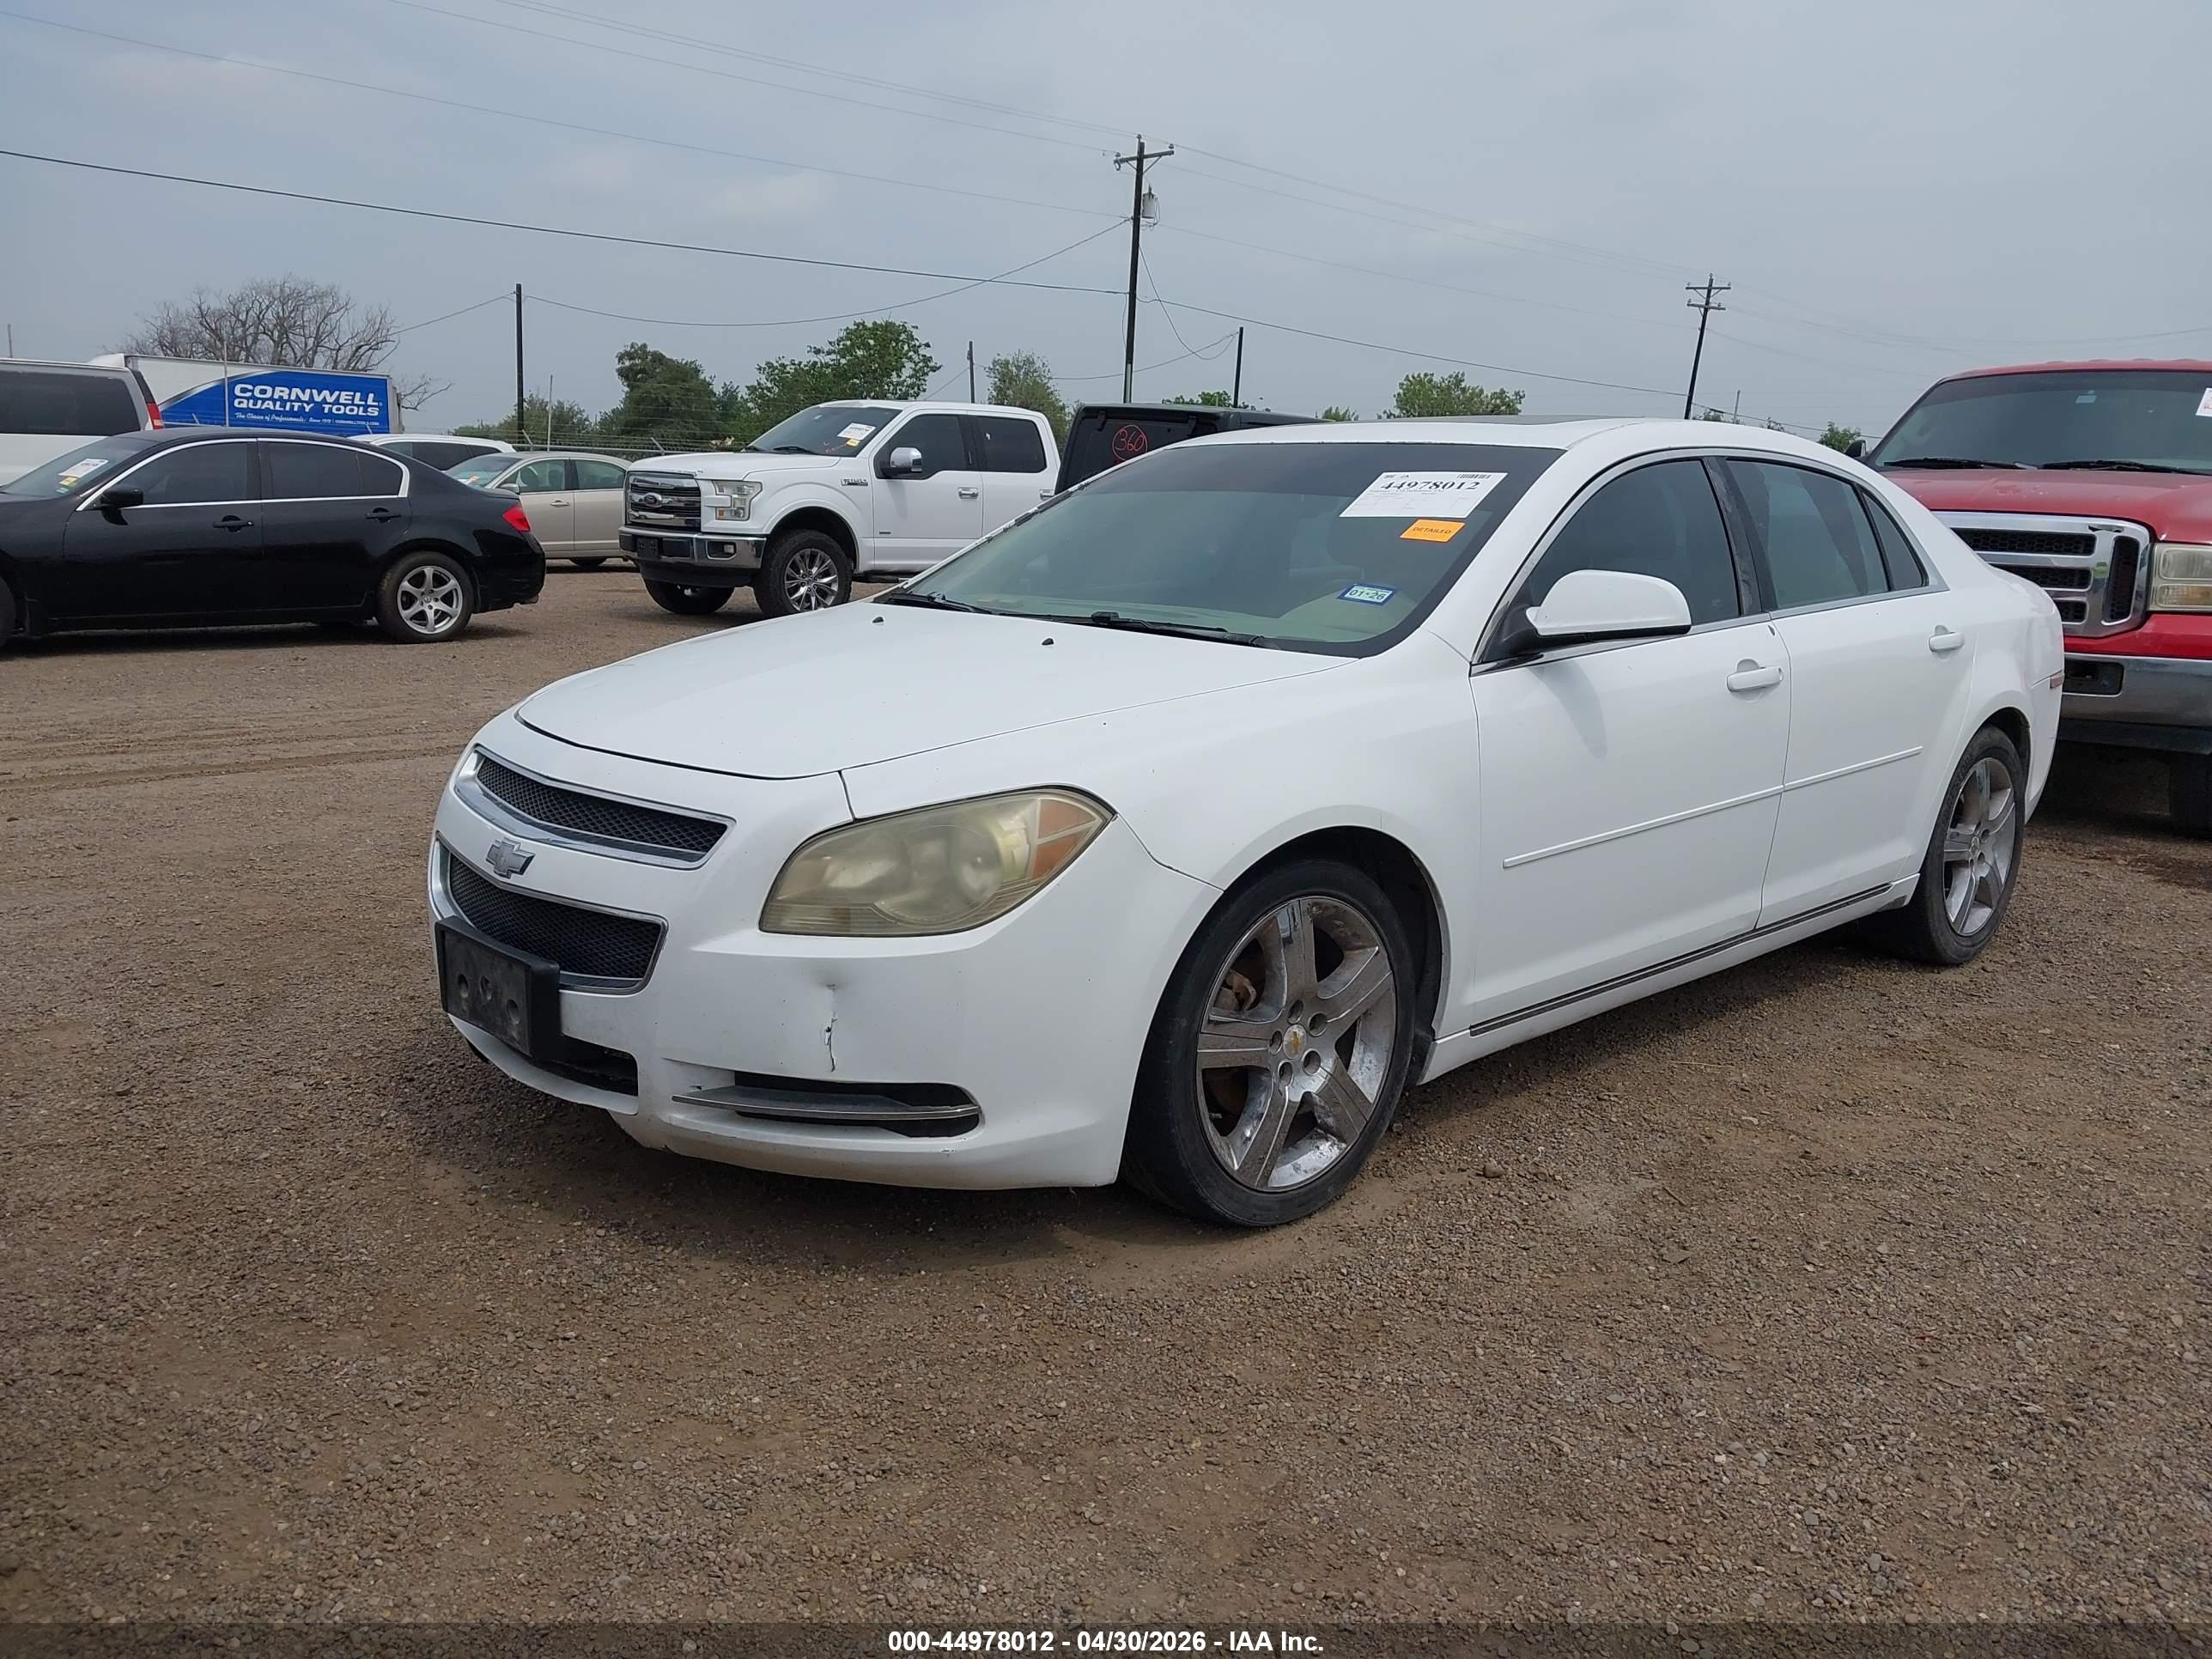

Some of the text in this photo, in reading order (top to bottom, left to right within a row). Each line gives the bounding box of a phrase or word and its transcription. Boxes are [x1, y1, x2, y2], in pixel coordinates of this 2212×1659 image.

[234, 384, 379, 405] CORNWELL
[234, 398, 380, 416] QUALITY TOOLS
[1115, 428, 1145, 452] 360
[1380, 480, 1481, 490] 44978012
[1412, 526, 1453, 535] DETAILED
